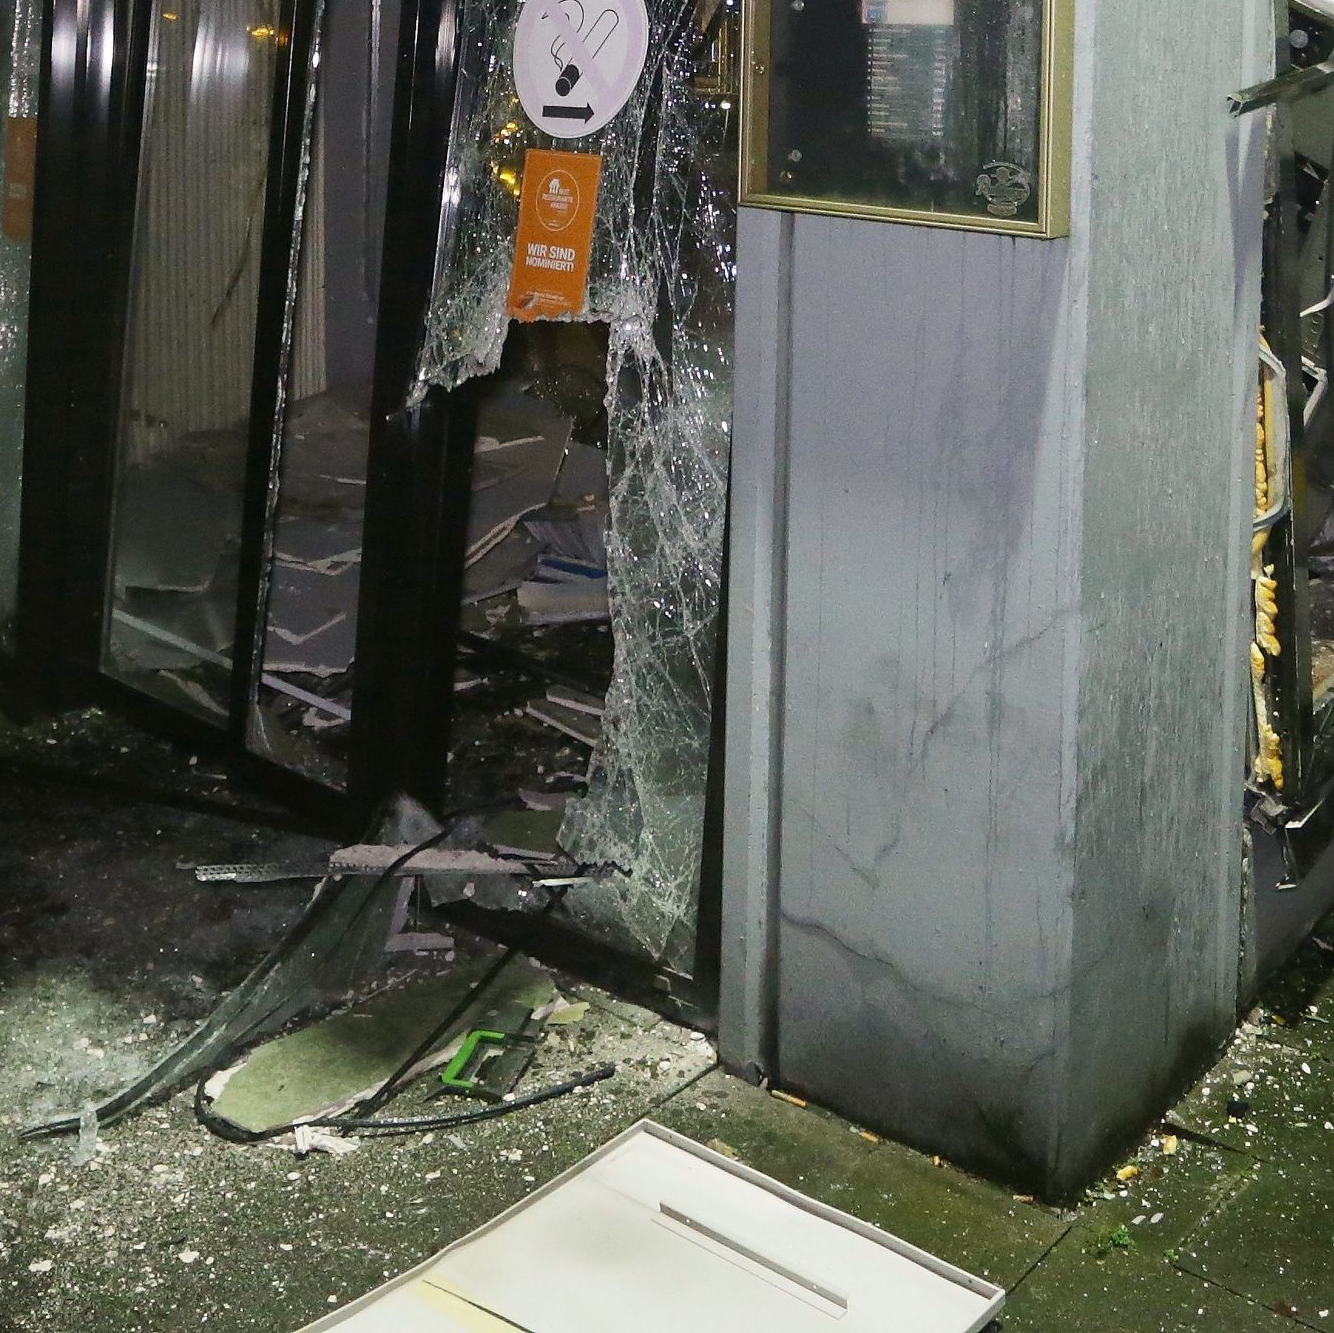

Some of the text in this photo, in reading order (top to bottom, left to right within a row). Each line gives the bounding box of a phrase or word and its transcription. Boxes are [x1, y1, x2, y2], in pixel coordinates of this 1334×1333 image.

[527, 242, 576, 261] WIR SIND
[525, 256, 575, 272] NOMINIERT!
